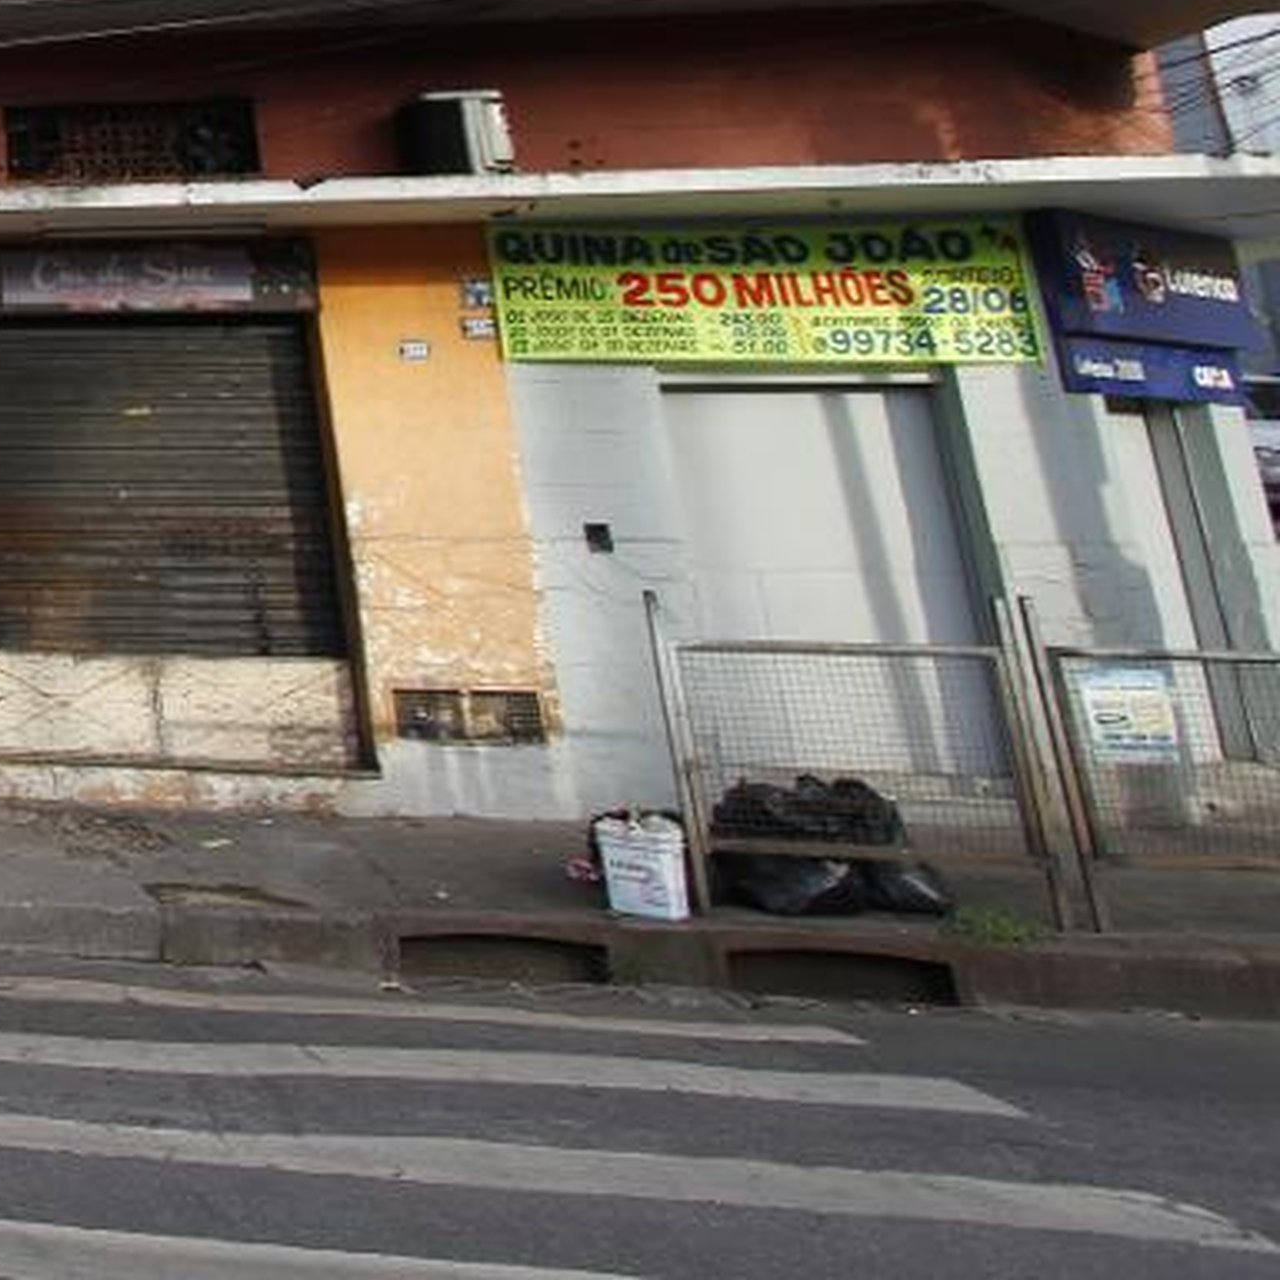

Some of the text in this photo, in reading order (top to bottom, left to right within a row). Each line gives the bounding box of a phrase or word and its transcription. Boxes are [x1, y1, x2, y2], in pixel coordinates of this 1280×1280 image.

[496, 231, 653, 265] QUINA
[701, 230, 810, 265] SÃO
[824, 226, 972, 263] JOÃO
[617, 270, 728, 308] 250
[732, 267, 915, 308] MILHÕES
[830, 328, 1039, 357] 99734-5283
